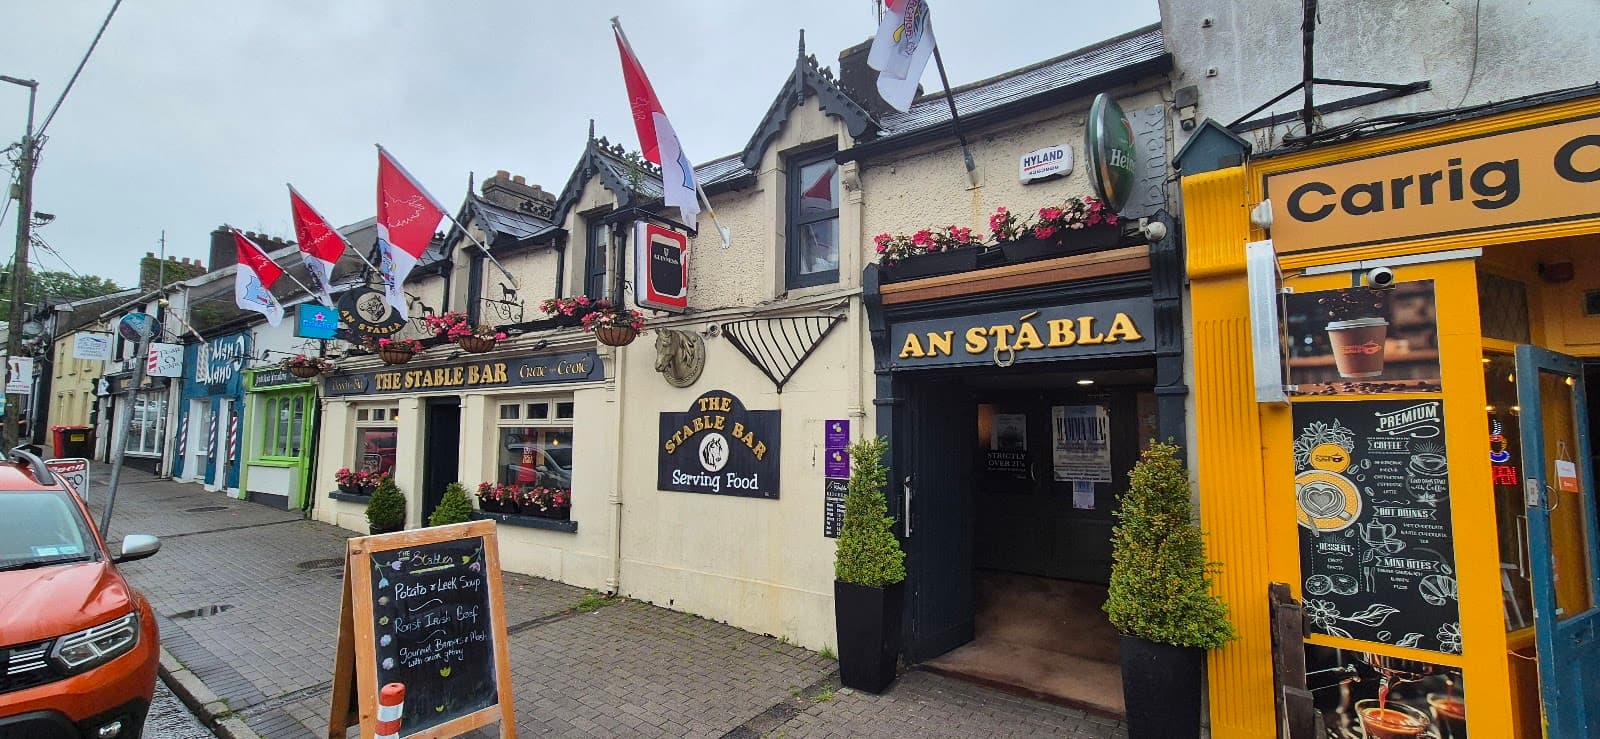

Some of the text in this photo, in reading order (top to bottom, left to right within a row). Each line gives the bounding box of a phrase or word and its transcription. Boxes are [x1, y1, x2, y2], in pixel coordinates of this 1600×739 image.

[1023, 149, 1063, 168] HYLAND
[1286, 157, 1521, 223] Carrig
[340, 310, 356, 323] AN
[898, 310, 1143, 358] AN STÁBLA
[374, 372, 402, 391] THE
[404, 366, 464, 389] STABLE
[467, 362, 508, 384] BAR
[698, 396, 733, 412] THE
[1379, 405, 1438, 429] PREMIUM
[664, 415, 768, 461] STABLE BAR
[1373, 441, 1402, 450] COFFEE
[987, 452, 1026, 460] STRICTLY
[988, 460, 1009, 468] OVER
[672, 469, 759, 492] Serving Food
[1379, 507, 1429, 519] HOT DRINKS
[1319, 542, 1351, 553] DESSERT
[1384, 558, 1432, 570] MINI BITES
[394, 582, 427, 601] Potato
[459, 575, 481, 592] Soup
[394, 604, 479, 634] Roast Irish Beef
